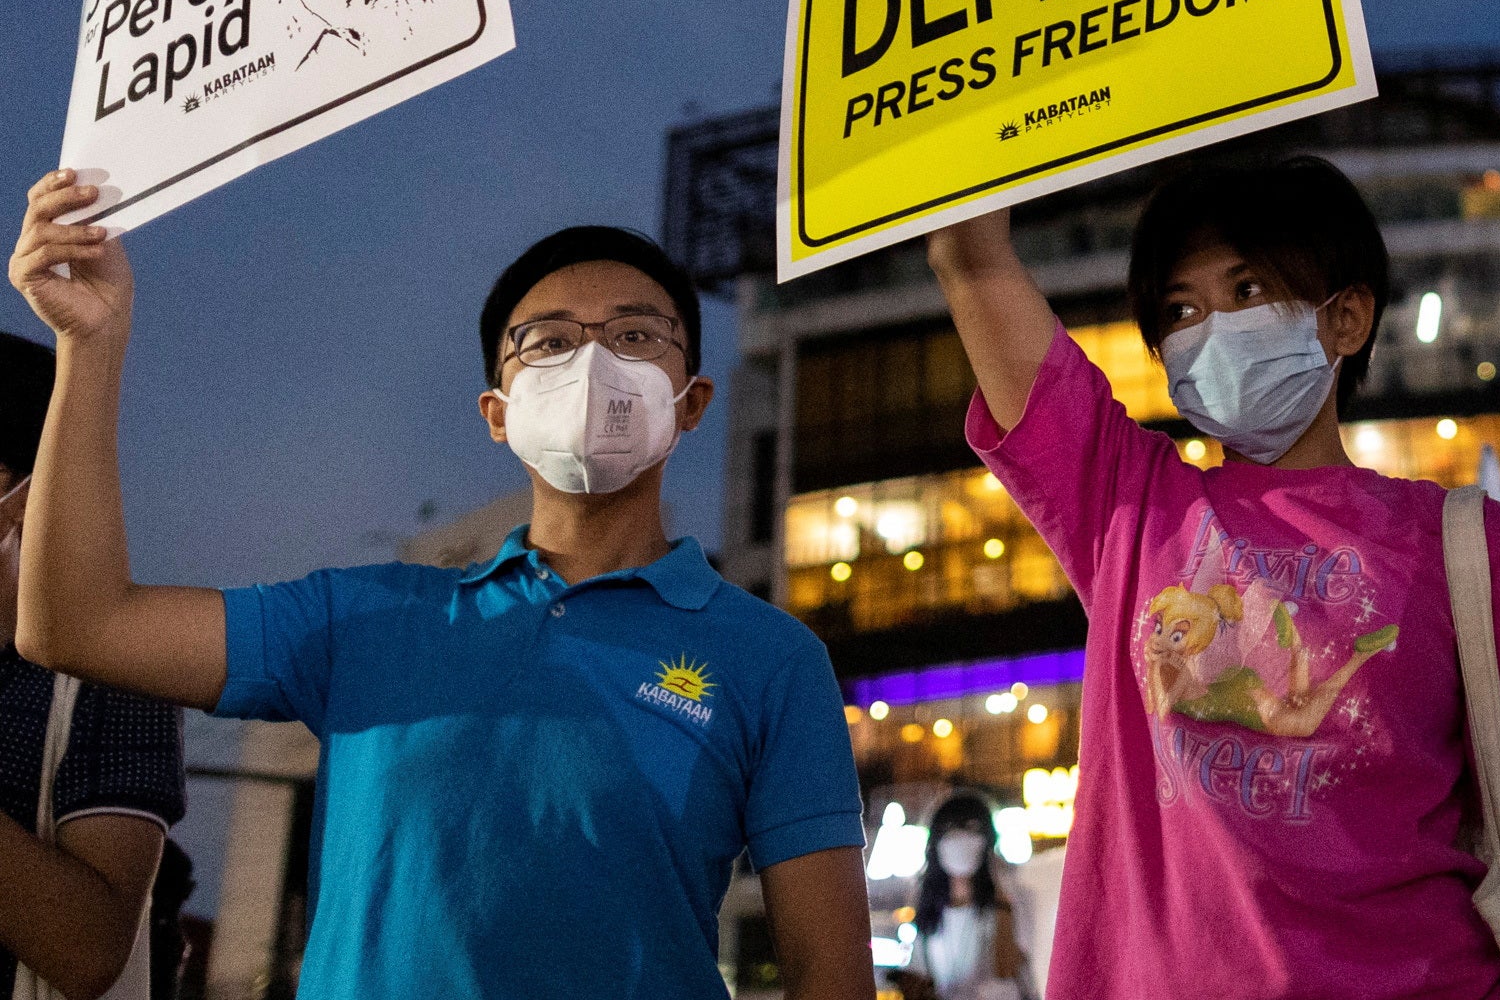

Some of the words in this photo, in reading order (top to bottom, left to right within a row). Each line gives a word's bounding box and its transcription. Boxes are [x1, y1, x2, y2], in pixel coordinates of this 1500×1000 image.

[203, 52, 276, 97] KABATAAN
[204, 64, 277, 104] PARTYLIST
[842, 46, 997, 139] PRESS
[1024, 86, 1111, 126] KABATAAN
[1025, 100, 1112, 132] PARTYLIST
[637, 682, 713, 722] KABATAAN
